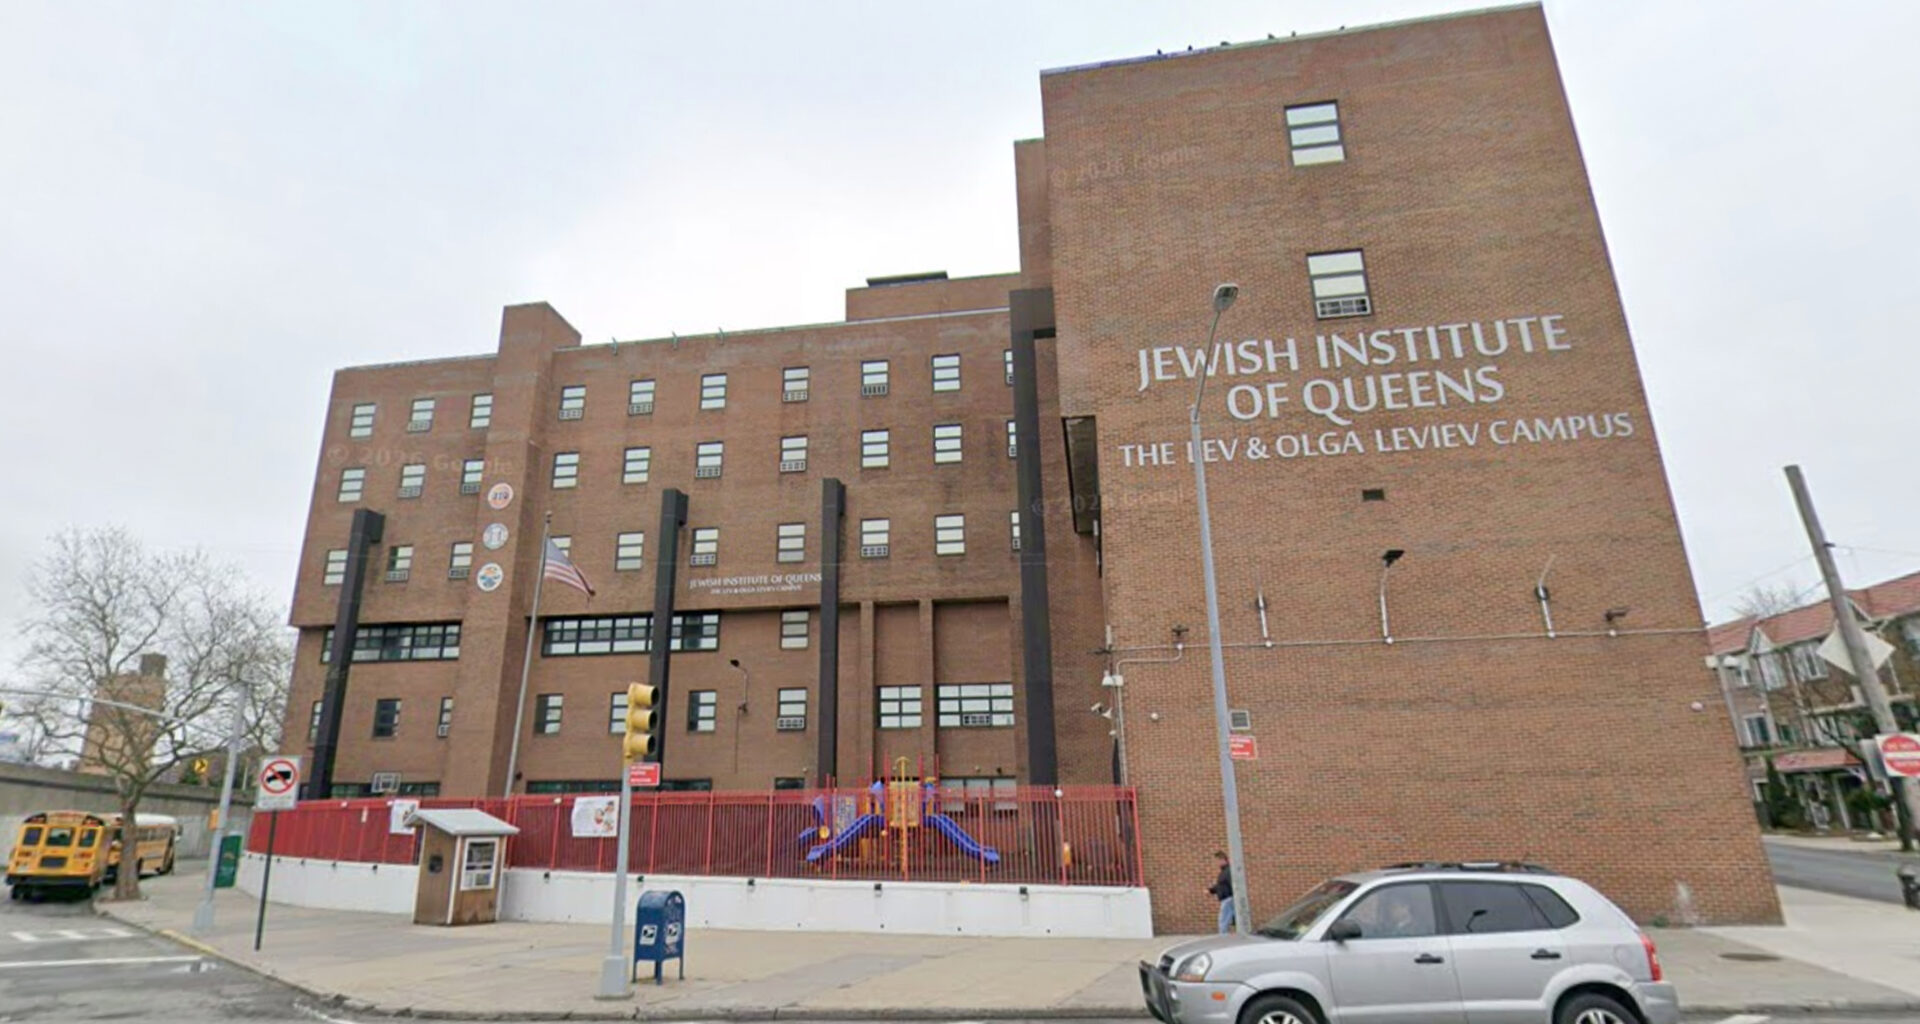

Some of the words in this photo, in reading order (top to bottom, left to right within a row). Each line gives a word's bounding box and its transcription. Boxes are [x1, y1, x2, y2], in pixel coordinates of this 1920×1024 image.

[1138, 338, 1299, 392] JEWISH
[1316, 314, 1571, 368] INSTITUTE
[1226, 382, 1289, 420] OF
[1302, 365, 1505, 426] QUEENS
[1118, 441, 1177, 468] THE
[1246, 436, 1272, 460] &
[1275, 430, 1365, 458] OLGA
[1375, 422, 1480, 452] LEVIEV
[1488, 412, 1635, 445] CAMPUS
[689, 577, 721, 590] JEWISH
[723, 575, 768, 587] INSTITUTE
